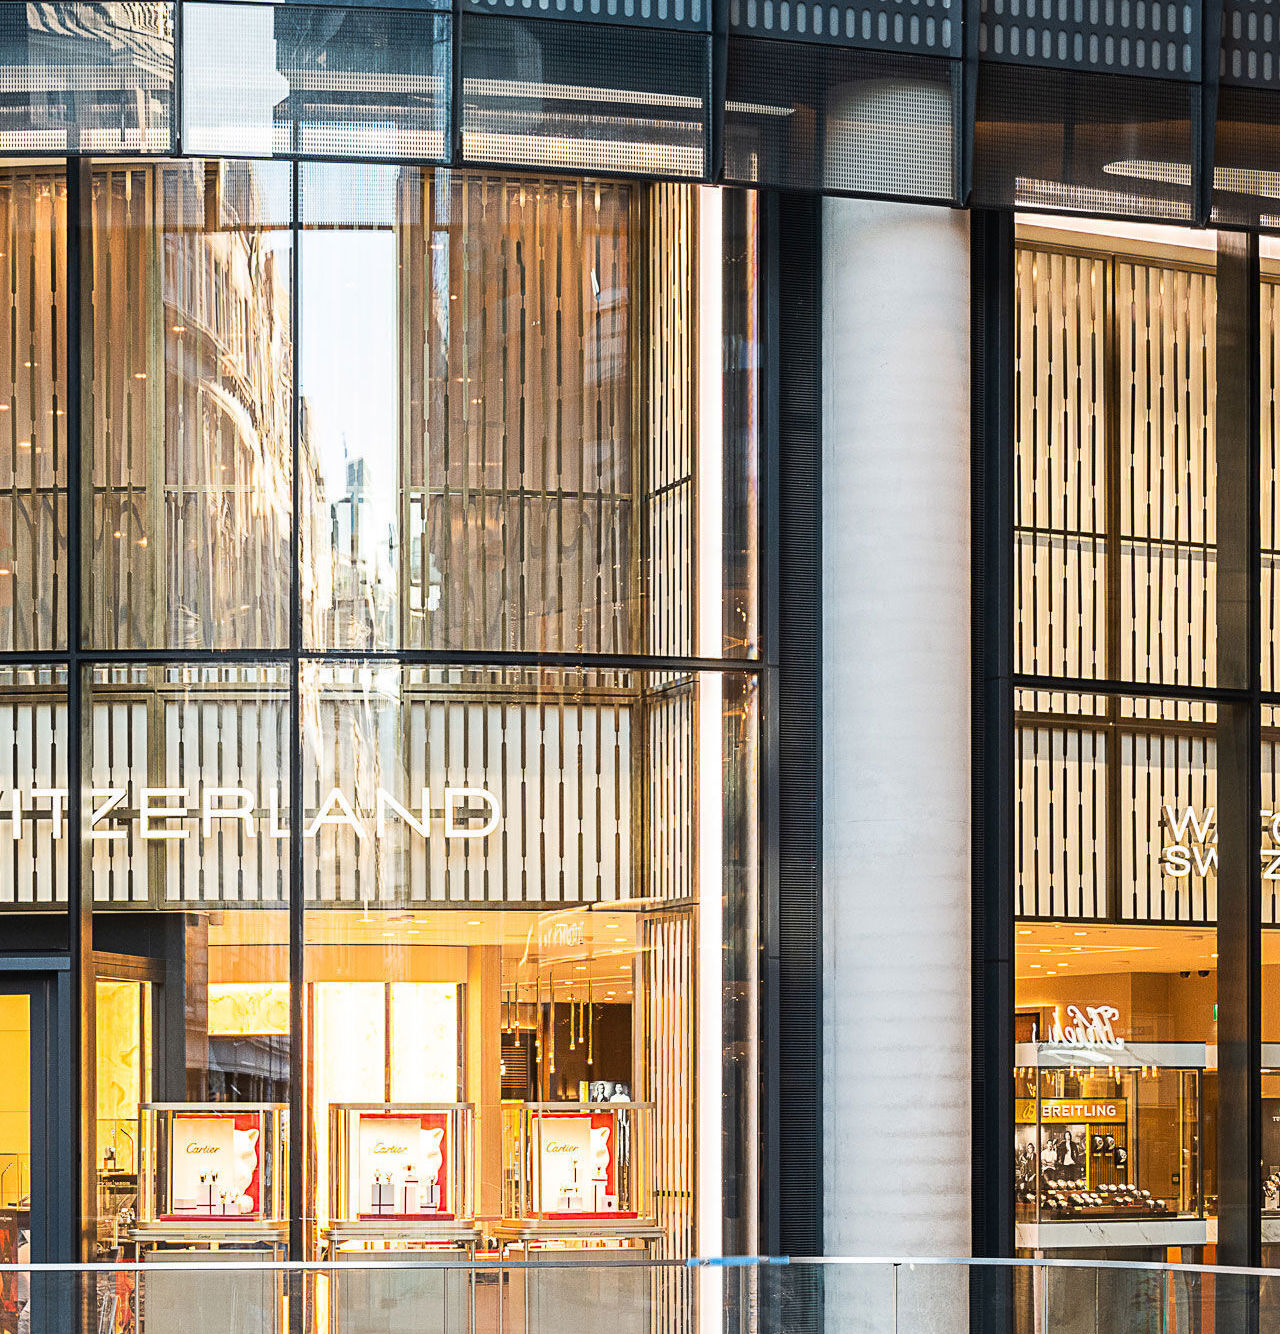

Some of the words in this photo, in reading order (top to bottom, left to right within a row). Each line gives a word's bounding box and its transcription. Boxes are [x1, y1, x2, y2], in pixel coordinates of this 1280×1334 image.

[1042, 1105, 1117, 1118] BREITLING
[186, 1142, 221, 1154] Cartier
[546, 1141, 580, 1153] Cartier
